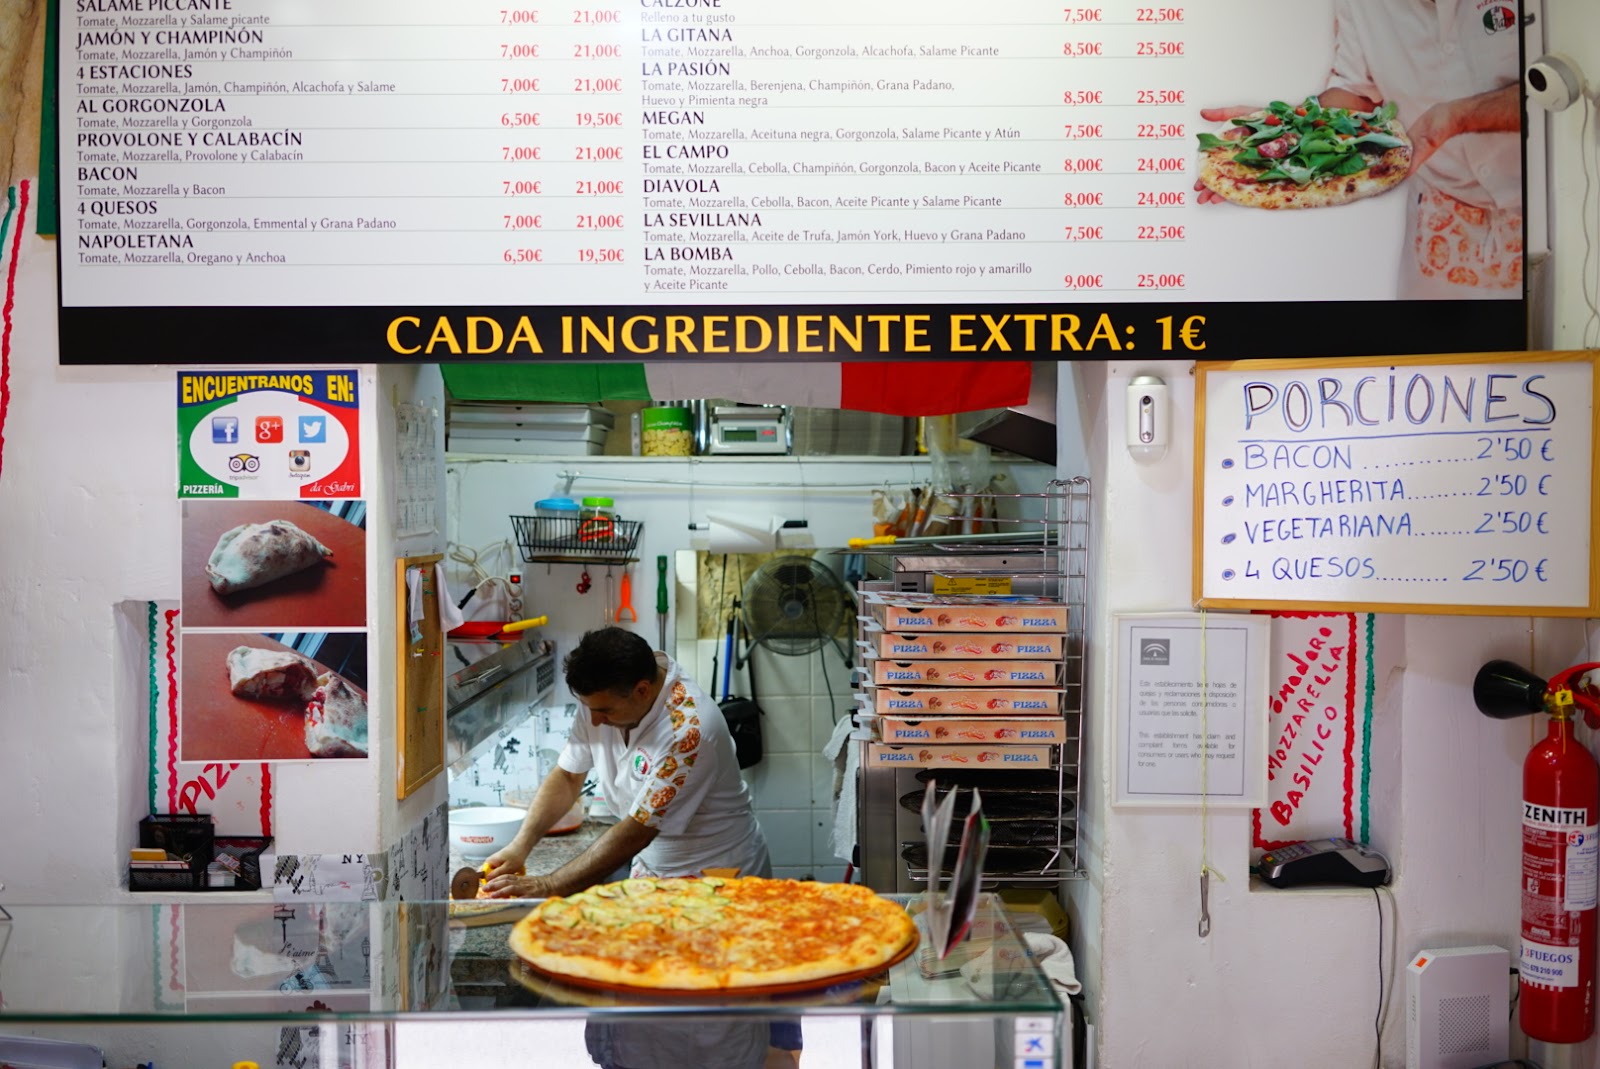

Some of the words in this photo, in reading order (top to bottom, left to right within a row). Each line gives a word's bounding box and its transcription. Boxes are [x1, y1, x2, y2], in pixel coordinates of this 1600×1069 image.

[76, 16, 118, 28] Tomate,
[122, 14, 177, 28] Mozzarella
[181, 18, 186, 28] y
[190, 13, 228, 27] Salame
[232, 14, 270, 28] picante
[500, 10, 538, 26] 7,00€
[574, 10, 620, 26] 21,00€
[1064, 9, 1101, 24] 7,50€
[1137, 8, 1183, 24] 22,50€
[78, 28, 134, 49] JAMÓN
[141, 32, 150, 44] Y
[156, 26, 262, 44] CHAMPIÑÓN
[642, 29, 662, 41] LA
[668, 28, 732, 42] GITANA
[77, 67, 84, 79] 4
[90, 64, 192, 79] ESTACIONES
[642, 62, 662, 76] LA
[668, 59, 730, 76] PASIÓN
[502, 79, 539, 94] 7,00€
[575, 78, 621, 94] 21,00€
[78, 100, 97, 113] AL
[103, 98, 225, 113] GORGONZOLA
[642, 94, 675, 105] Huevo
[679, 97, 687, 108] y
[689, 93, 735, 108] Pimienta
[739, 98, 768, 108] negra
[1064, 91, 1102, 106] 8,50€
[1138, 90, 1184, 106] 25,50€
[643, 111, 704, 124] MEGAN
[78, 133, 182, 147] PROVOLONE
[188, 133, 197, 146] Y
[203, 129, 301, 146] CALABACÍN
[76, 150, 118, 163] Tomate,
[123, 150, 181, 163] Mozzarella,
[186, 150, 237, 161] Provolone
[241, 153, 247, 163] y
[251, 149, 303, 162] Calabacín
[503, 147, 540, 162] 7,00€
[576, 147, 622, 162] 21,00€
[644, 145, 661, 158] EL
[667, 145, 728, 158] CAMPO
[1064, 158, 1102, 174] 8,00€
[1138, 158, 1184, 174] 24,00€
[78, 167, 137, 181] BACON
[644, 179, 719, 192] DIAVOLA
[78, 202, 85, 214] 4
[91, 201, 157, 217] QUESOS
[77, 216, 120, 230] Tomate,
[124, 218, 183, 230] Mozzarella,
[186, 218, 250, 232] Gorgonzola,
[254, 217, 307, 229] Emmental
[311, 221, 317, 232] y
[320, 218, 353, 229] Grana
[357, 217, 396, 231] Padano
[504, 215, 541, 231] 7,00€
[577, 215, 623, 230] 21,00€
[644, 214, 664, 226] LA
[670, 213, 761, 227] SEVILLANA
[79, 234, 193, 248] NAPOLETANA
[642, 230, 685, 242] Tomate,
[690, 230, 748, 242] Mozzarella,
[752, 231, 784, 241] Aceite
[788, 230, 799, 241] de
[802, 230, 834, 242] Trufa,
[838, 230, 870, 243] Jamón
[874, 229, 900, 242] York,
[904, 230, 938, 240] Huevo
[941, 233, 947, 244] y
[950, 229, 982, 240] Grana
[987, 228, 1025, 242] Padano
[1066, 226, 1102, 242] 7,50€
[1138, 226, 1184, 241] 22,50€
[645, 248, 664, 260] LA
[671, 247, 732, 260] BOMBA
[387, 316, 543, 354] CADA
[562, 315, 931, 353] INGREDIENTE
[951, 313, 1134, 351] EXTRA:
[1156, 316, 1206, 350] 1€
[182, 375, 313, 403] ENCUENTRANOS
[327, 375, 354, 402] EN:
[1243, 366, 1556, 432] PORCIONES
[1245, 444, 1352, 470] BACON
[183, 483, 224, 494] PIZZERÍA
[323, 481, 355, 495] Gabri
[1246, 479, 1405, 508] MARGHERITA
[1244, 513, 1412, 544] VEGETARIANA
[1244, 560, 1260, 580] 4
[1273, 557, 1376, 581] QUESOS
[898, 617, 933, 626] PIZZA
[1022, 618, 1057, 626] PIZZA
[893, 645, 928, 653] PIZZA
[1017, 645, 1052, 653] PIZZA
[887, 671, 921, 680] PIZZA
[1010, 672, 1045, 680] PIZZA
[889, 700, 923, 708] PIZZA
[1013, 700, 1048, 709] PIZZA
[895, 730, 930, 738] PIZZA
[1020, 730, 1055, 738] PIZZA
[880, 753, 914, 761] PIZZA
[1004, 754, 1038, 762] PIZZA
[1271, 706, 1337, 826] BASILICO
[1525, 804, 1585, 825] ZENITH
[1525, 948, 1573, 964] 3FUEGOS
